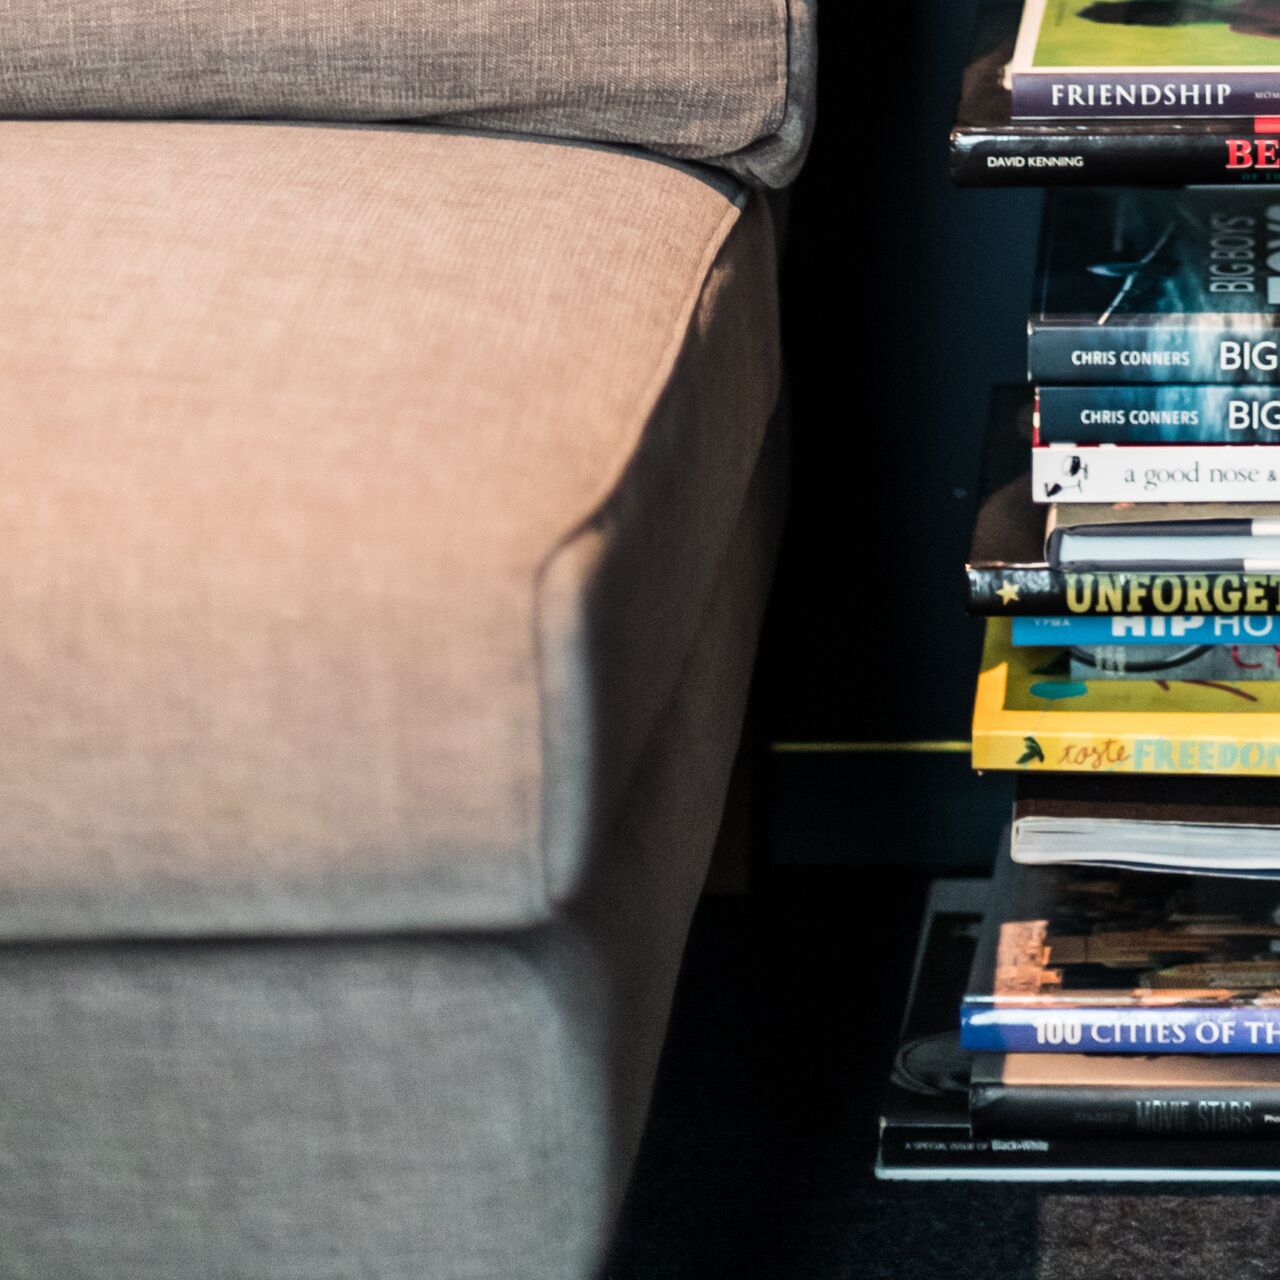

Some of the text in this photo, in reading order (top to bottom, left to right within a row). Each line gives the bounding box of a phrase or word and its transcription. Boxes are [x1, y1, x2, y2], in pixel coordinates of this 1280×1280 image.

[1051, 83, 1232, 106] FRIENDSHIP
[987, 156, 1084, 168] DAVID KENNING
[1209, 263, 1255, 292] BIG
[1071, 350, 1190, 366] CHRIS CONNERS
[1220, 341, 1278, 371] BIG
[1080, 409, 1199, 425] CHRIS CONNERS
[1124, 470, 1135, 483] a
[1144, 461, 1199, 490] good
[1210, 469, 1260, 483] nose
[1267, 470, 1278, 482] &
[1111, 616, 1205, 637] HIP
[1034, 1019, 1082, 1045] 100
[1090, 1021, 1187, 1045] CITIES
[1195, 1021, 1236, 1045] OF
